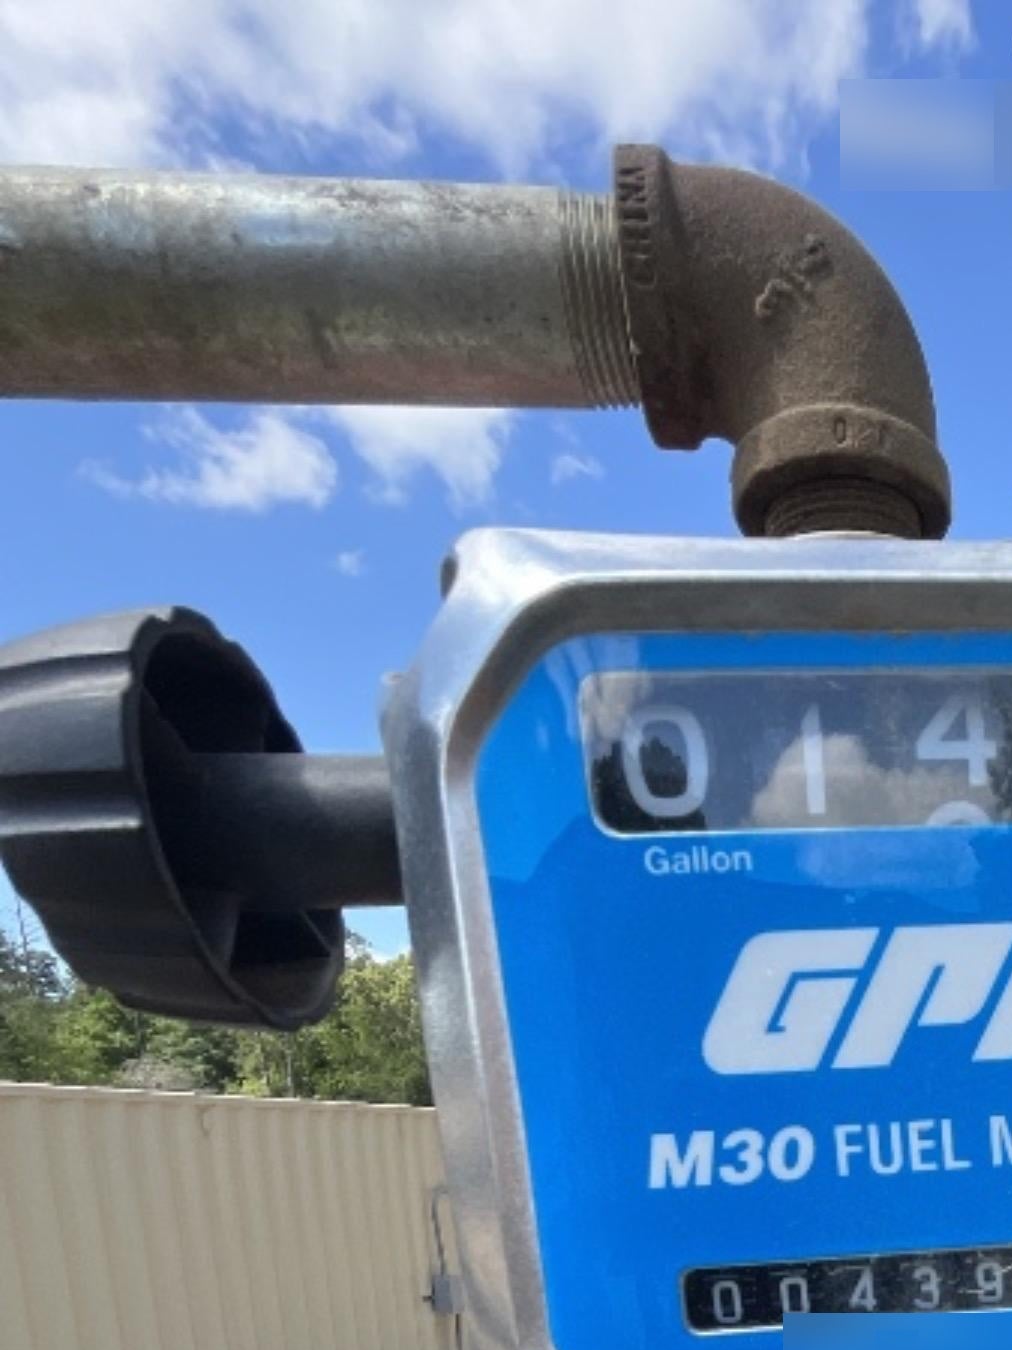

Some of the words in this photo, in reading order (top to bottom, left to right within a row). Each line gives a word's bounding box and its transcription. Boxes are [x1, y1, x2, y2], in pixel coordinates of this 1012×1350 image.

[644, 845, 753, 876] Gallon
[648, 1126, 815, 1189] M30
[834, 1119, 972, 1177] FUEL
